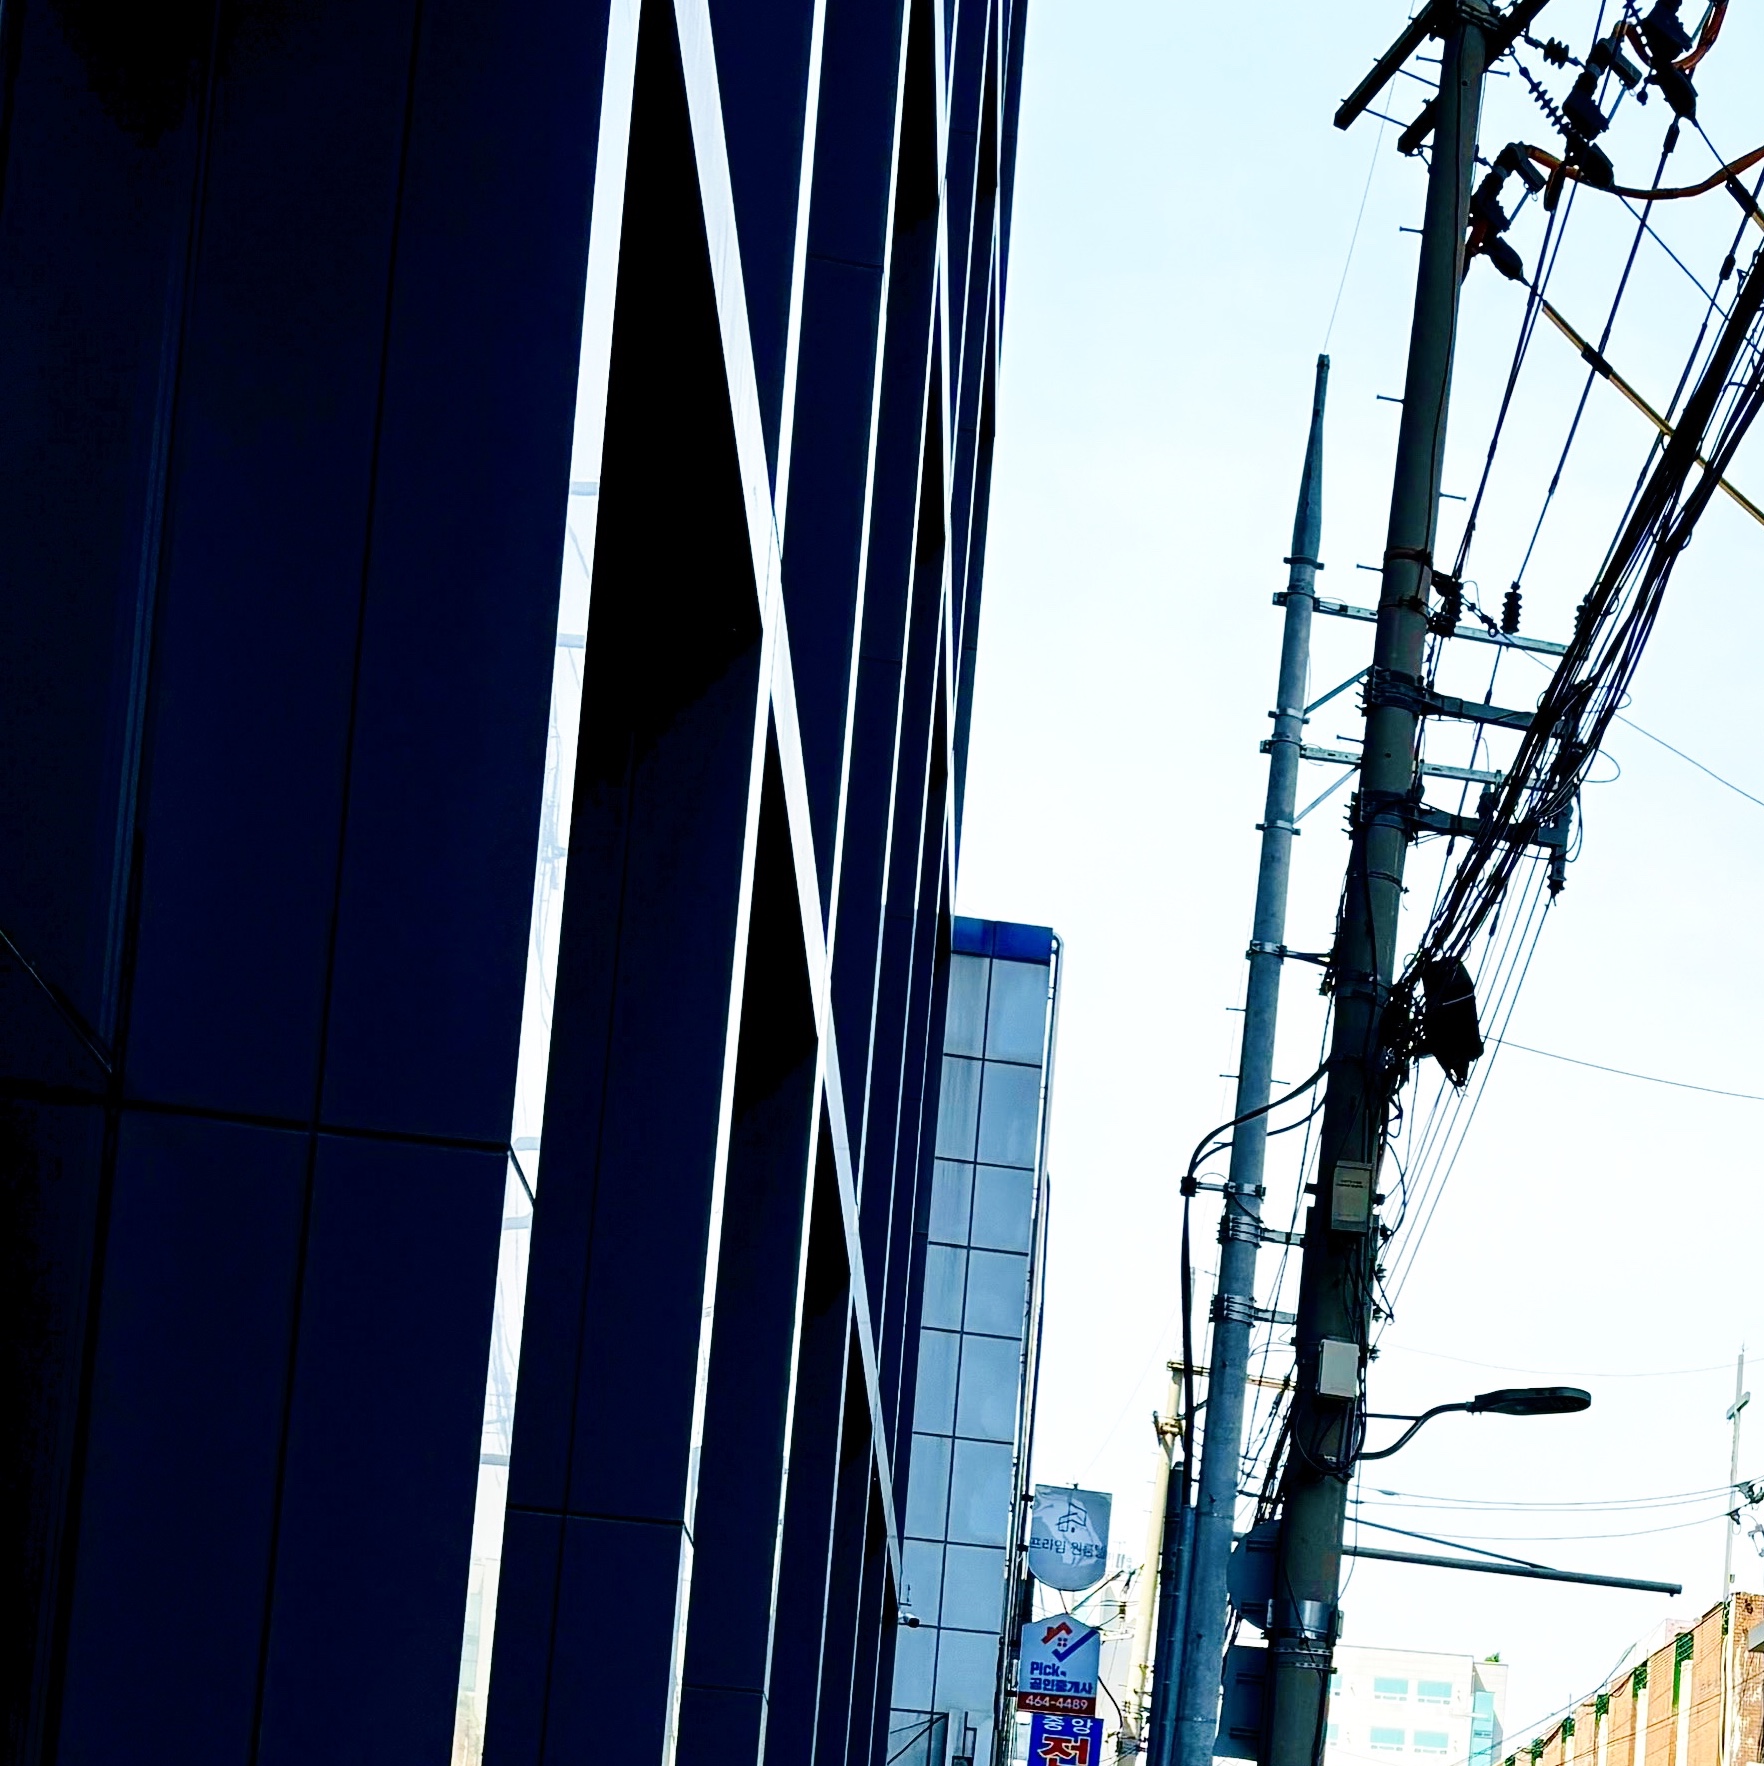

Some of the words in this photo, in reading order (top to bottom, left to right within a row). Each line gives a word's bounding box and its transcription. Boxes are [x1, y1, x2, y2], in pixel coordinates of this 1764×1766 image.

[1029, 1678, 1093, 1695] 공인중개사
[1026, 1694, 1088, 1710] 464-4489
[1042, 1715, 1093, 1734] 중앙
